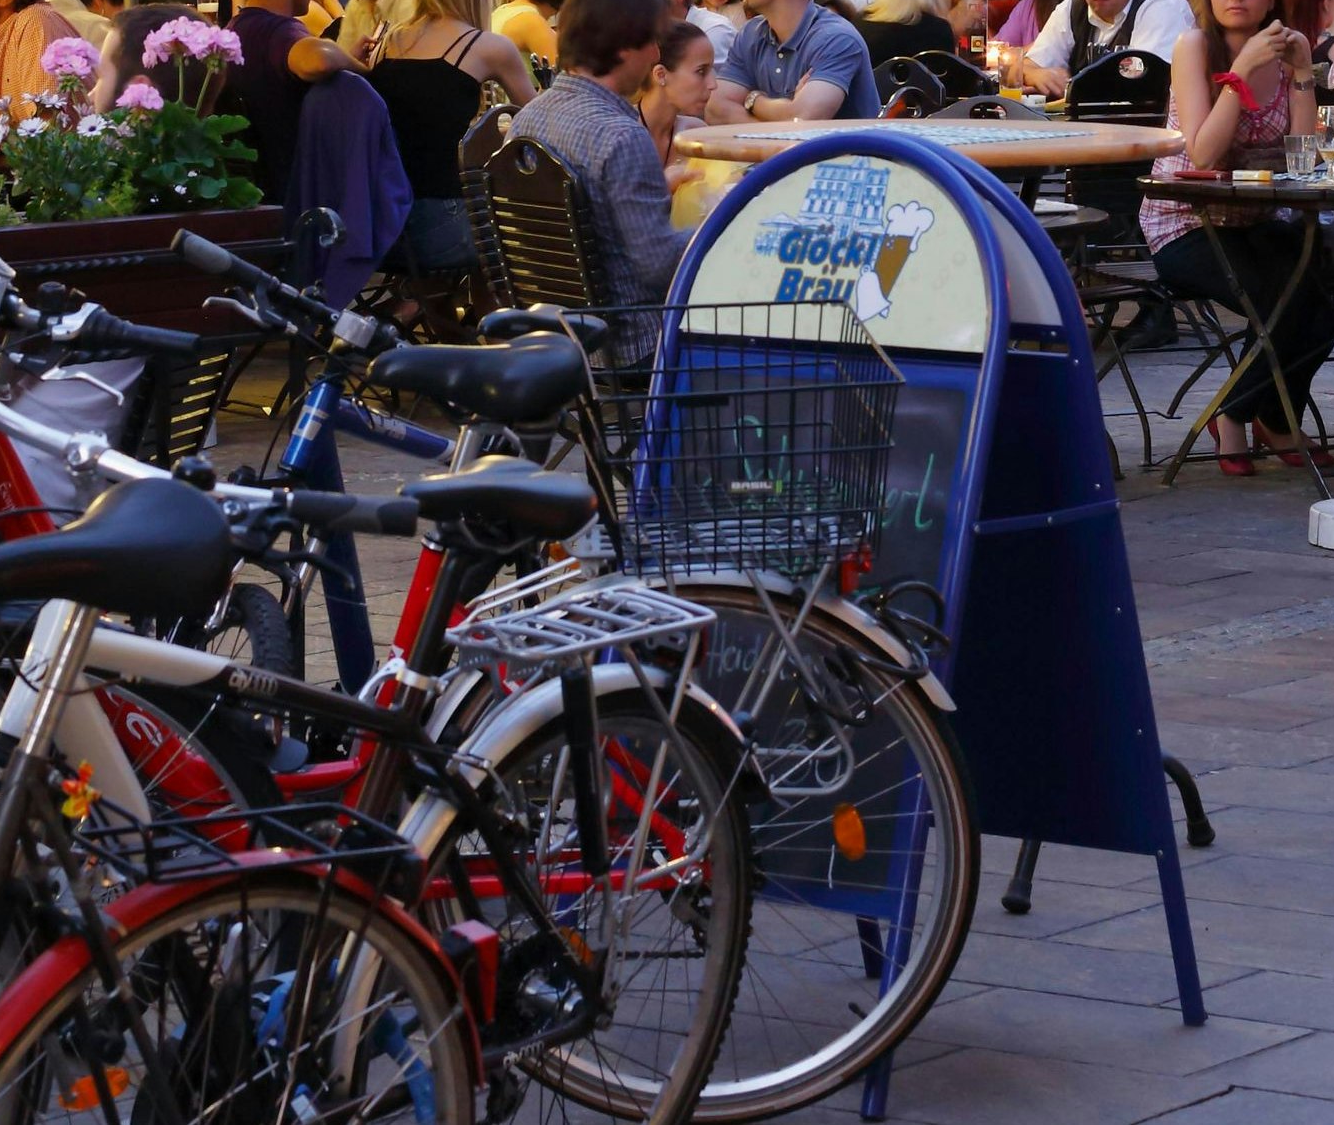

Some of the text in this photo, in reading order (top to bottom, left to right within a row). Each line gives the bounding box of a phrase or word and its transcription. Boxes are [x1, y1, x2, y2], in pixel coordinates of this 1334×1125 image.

[778, 224, 879, 268] Glöckl
[775, 264, 856, 307] Bräu
[730, 480, 773, 491] BASIL
